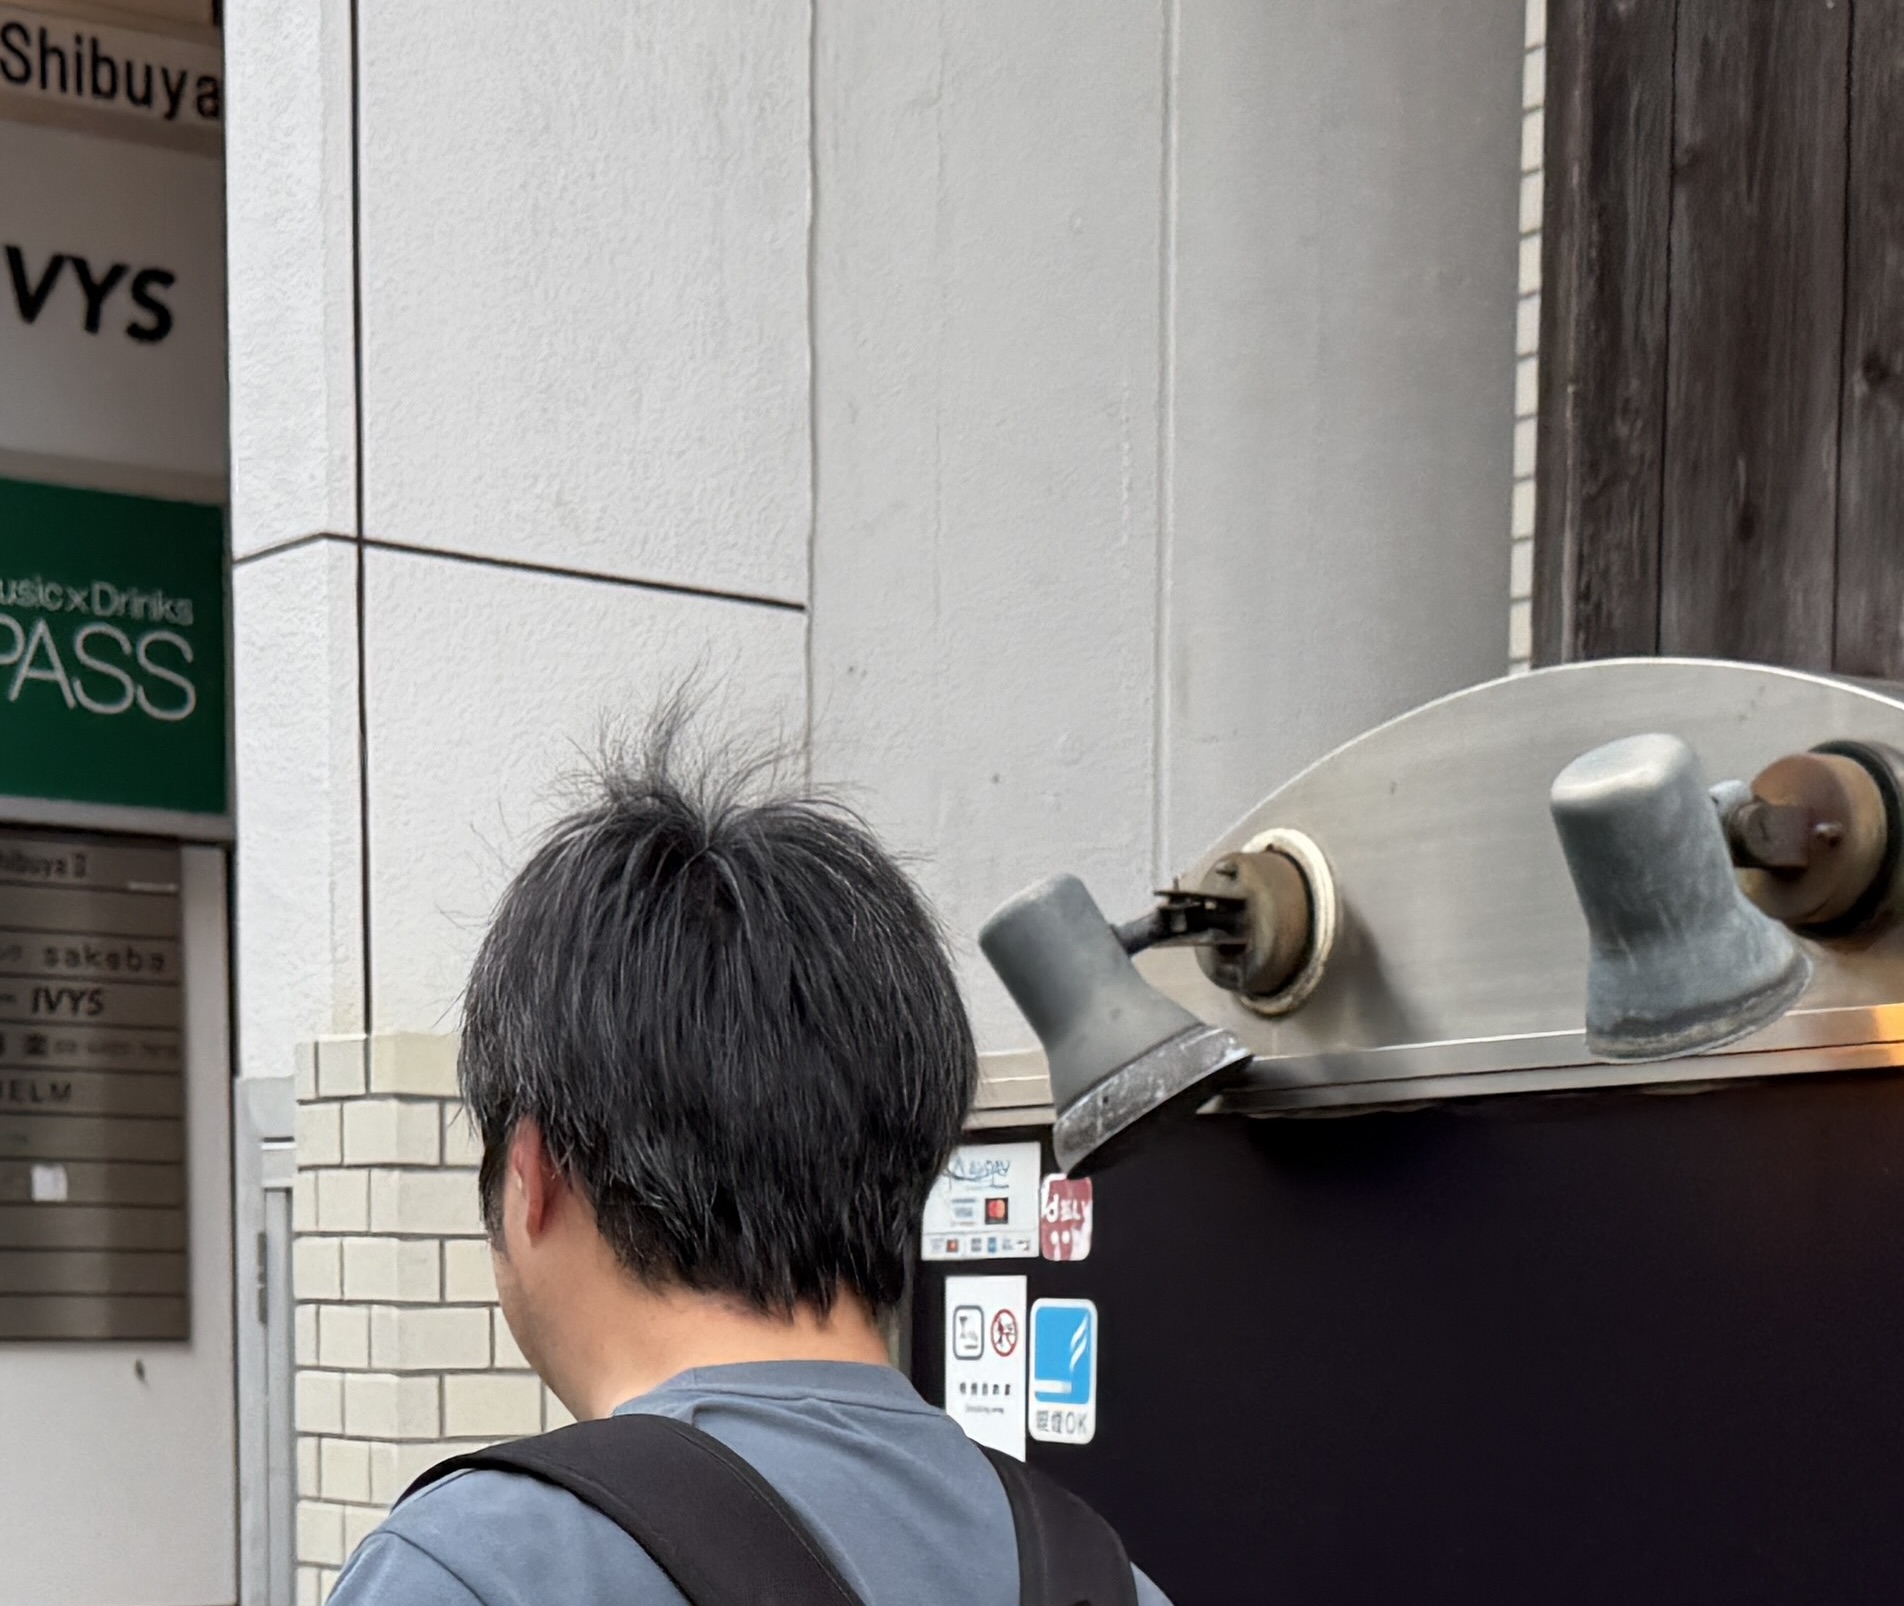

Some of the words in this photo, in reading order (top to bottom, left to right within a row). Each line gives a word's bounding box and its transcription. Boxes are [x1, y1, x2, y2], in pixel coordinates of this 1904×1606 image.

[0, 21, 220, 121] Shibuya
[42, 941, 167, 973] sakeba
[29, 986, 106, 1017] IVYS
